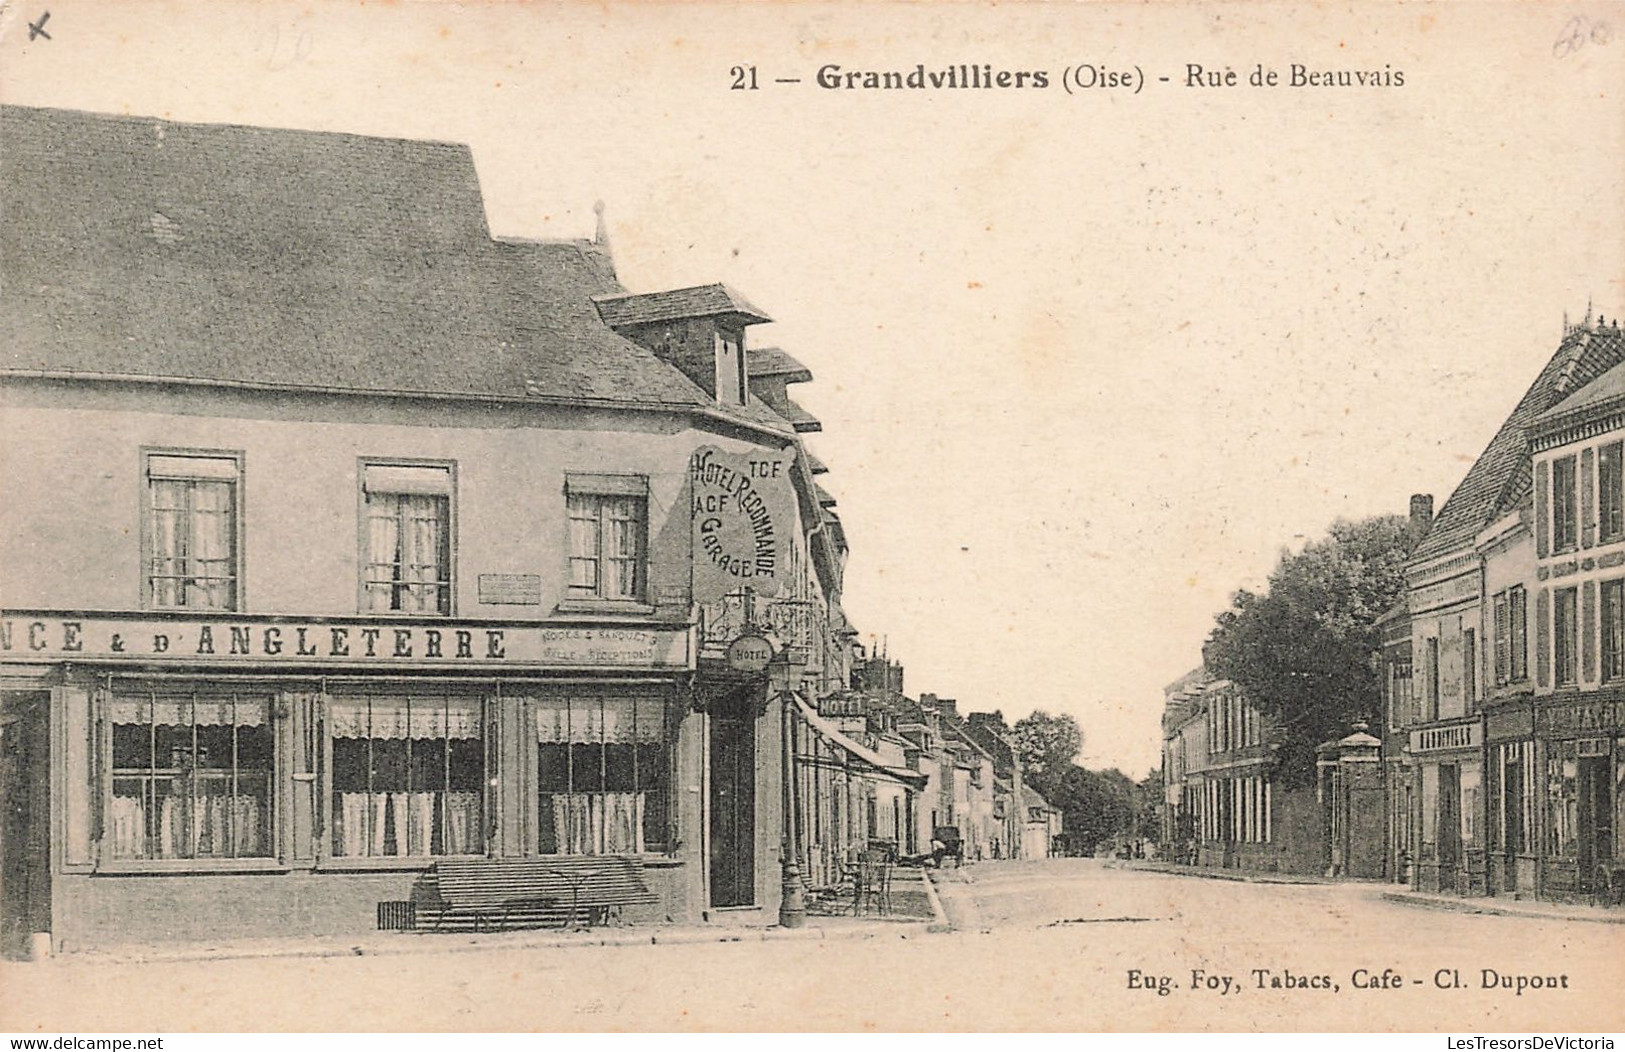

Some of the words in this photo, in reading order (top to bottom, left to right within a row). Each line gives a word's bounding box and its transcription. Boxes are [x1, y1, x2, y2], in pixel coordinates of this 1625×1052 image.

[730, 65, 759, 90] 21
[816, 64, 1049, 89] Grandvilliers
[1062, 64, 1145, 94] (Oise)
[1185, 64, 1237, 87] Rue
[1249, 64, 1279, 87] de
[1289, 64, 1405, 87] Beauvais
[701, 518, 753, 577] GARAGE
[110, 634, 125, 652] &
[736, 650, 767, 661] HOTEL
[1127, 969, 1179, 996] Eug.
[1191, 969, 1242, 995] Foy,
[1252, 968, 1340, 994] Tabacs,
[1352, 968, 1402, 990] Cafe
[1434, 969, 1468, 989] Cl.
[1481, 969, 1569, 996] Dupont
